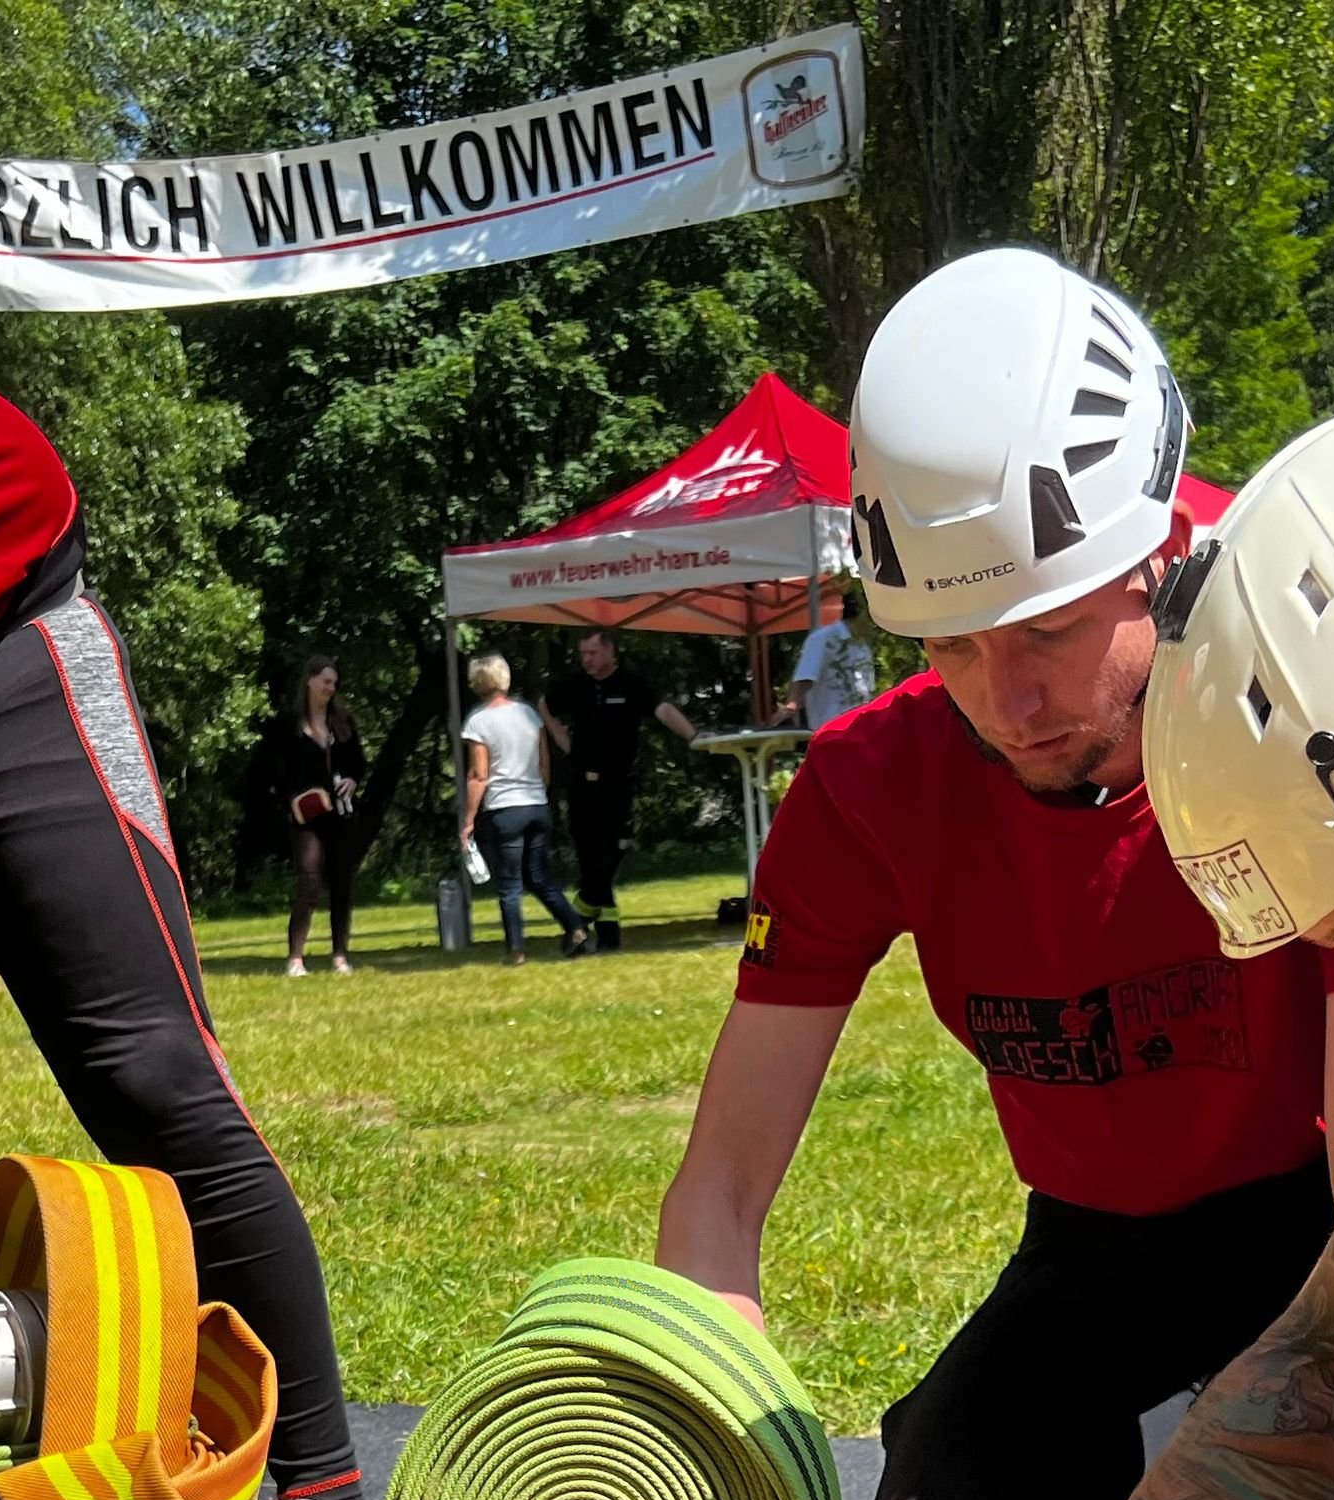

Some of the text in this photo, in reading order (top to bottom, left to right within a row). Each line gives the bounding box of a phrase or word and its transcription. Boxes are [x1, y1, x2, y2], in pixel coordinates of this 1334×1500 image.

[236, 77, 714, 247] WILLKOMMEN
[509, 546, 731, 588] www.feuerwehr-harz.de
[937, 561, 1016, 589] SKYLOTEC
[978, 1032, 1119, 1082] LOESCH
